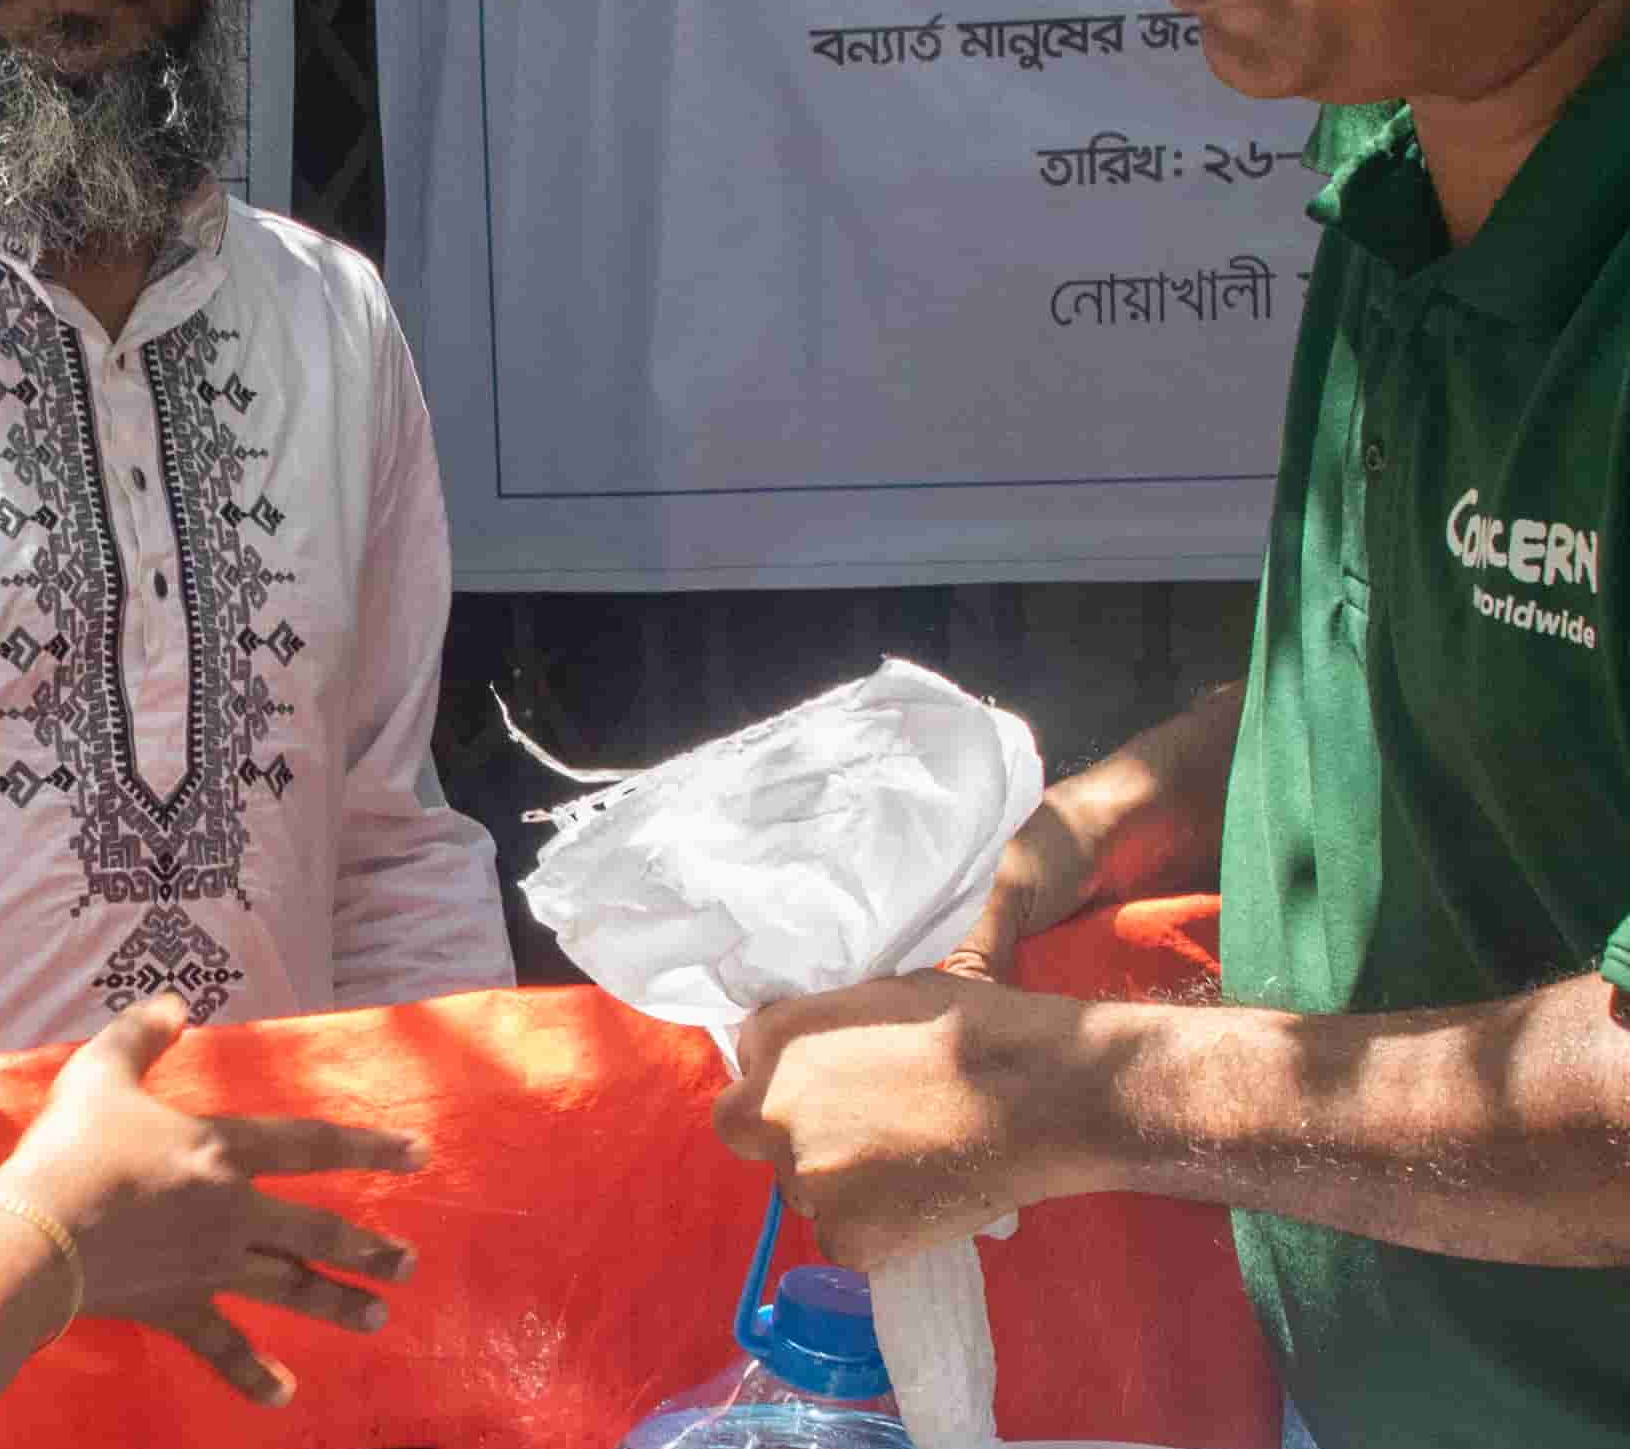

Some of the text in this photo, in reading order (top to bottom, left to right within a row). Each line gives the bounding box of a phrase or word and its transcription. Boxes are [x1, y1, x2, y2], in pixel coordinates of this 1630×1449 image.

[808, 11, 945, 67] বন্যার্ত
[955, 15, 1126, 71] মানুষের
[1050, 255, 1277, 327] নোয়াখালী
